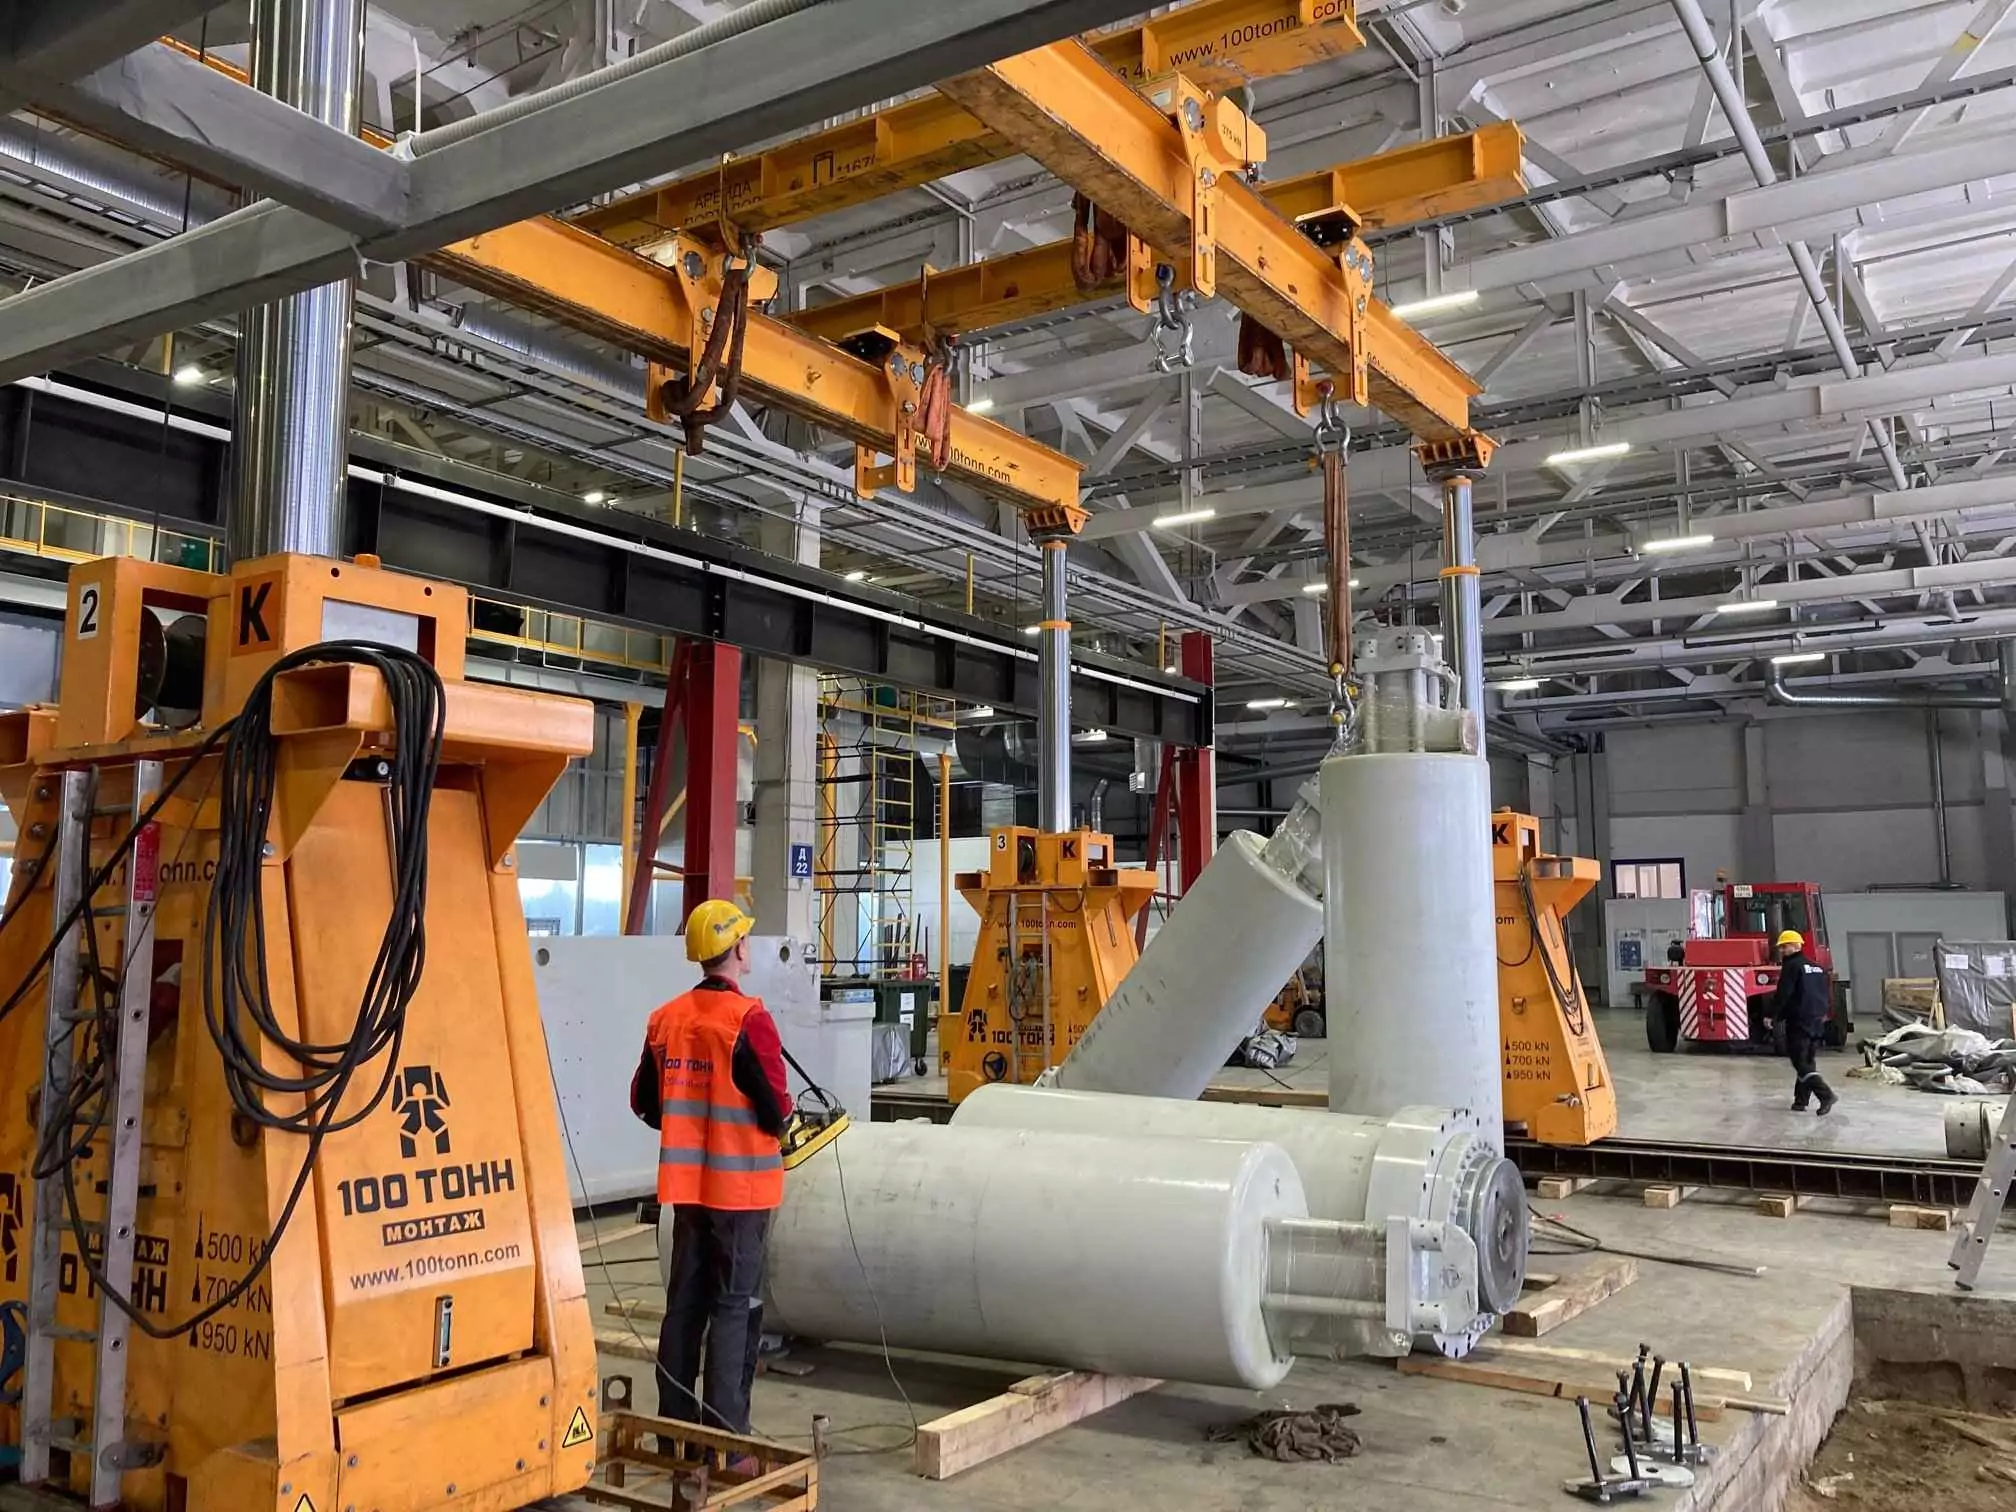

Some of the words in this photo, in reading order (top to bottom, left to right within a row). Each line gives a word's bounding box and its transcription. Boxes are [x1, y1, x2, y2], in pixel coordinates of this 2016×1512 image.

[79, 589, 98, 634] 2
[997, 835, 1006, 850] 3
[795, 862, 808, 874] 22
[1511, 1041, 1532, 1051] 500
[1535, 1040, 1549, 1051] kN
[1512, 1055, 1532, 1066] 700
[1536, 1055, 1550, 1065] kN
[1513, 1069, 1533, 1079] 950
[1537, 1069, 1551, 1080] kN
[336, 1174, 408, 1217] 100
[416, 1158, 515, 1204] ТОНН
[385, 1211, 482, 1244] МОНТАЖ
[207, 1232, 242, 1264] 500
[350, 1243, 521, 1291] www.100tonn.com
[205, 1276, 241, 1308] 700
[245, 1280, 272, 1314] kN
[202, 1320, 237, 1354] 950
[243, 1329, 270, 1361] kN
